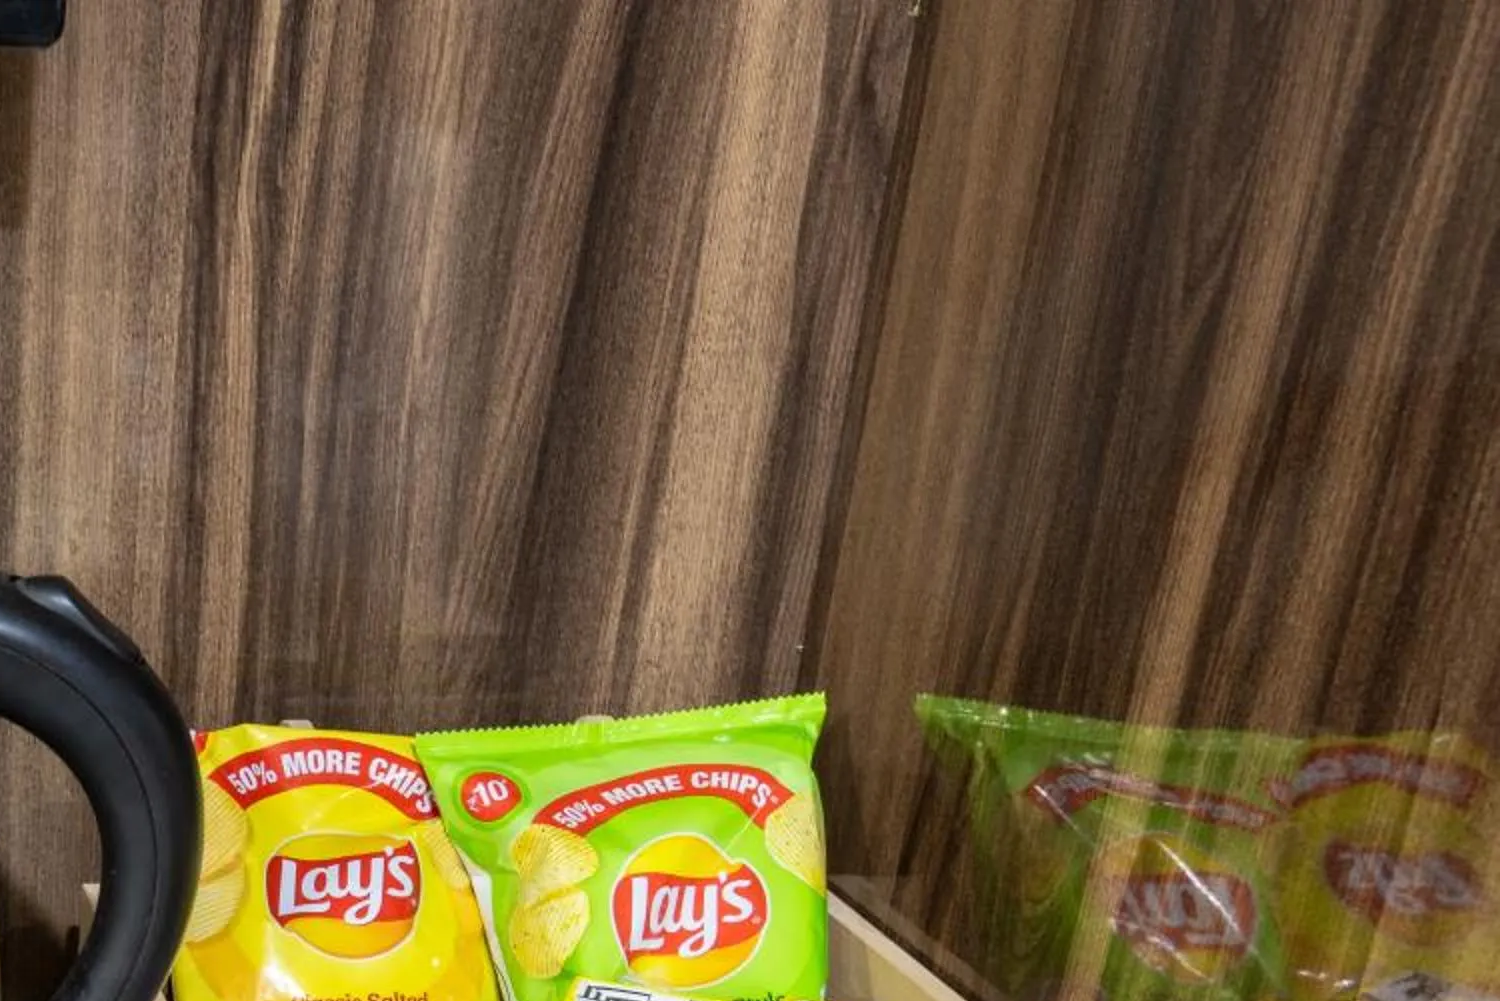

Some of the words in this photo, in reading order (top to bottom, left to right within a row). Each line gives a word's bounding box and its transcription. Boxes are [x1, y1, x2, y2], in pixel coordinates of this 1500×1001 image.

[228, 760, 278, 795] 50%
[280, 749, 363, 778] MORE
[368, 757, 435, 814] CHIPS
[552, 798, 606, 829] 50%
[600, 774, 685, 806] MORE
[690, 771, 773, 809] CHIPS
[277, 845, 418, 926] Lay's
[627, 870, 753, 959] Lay's
